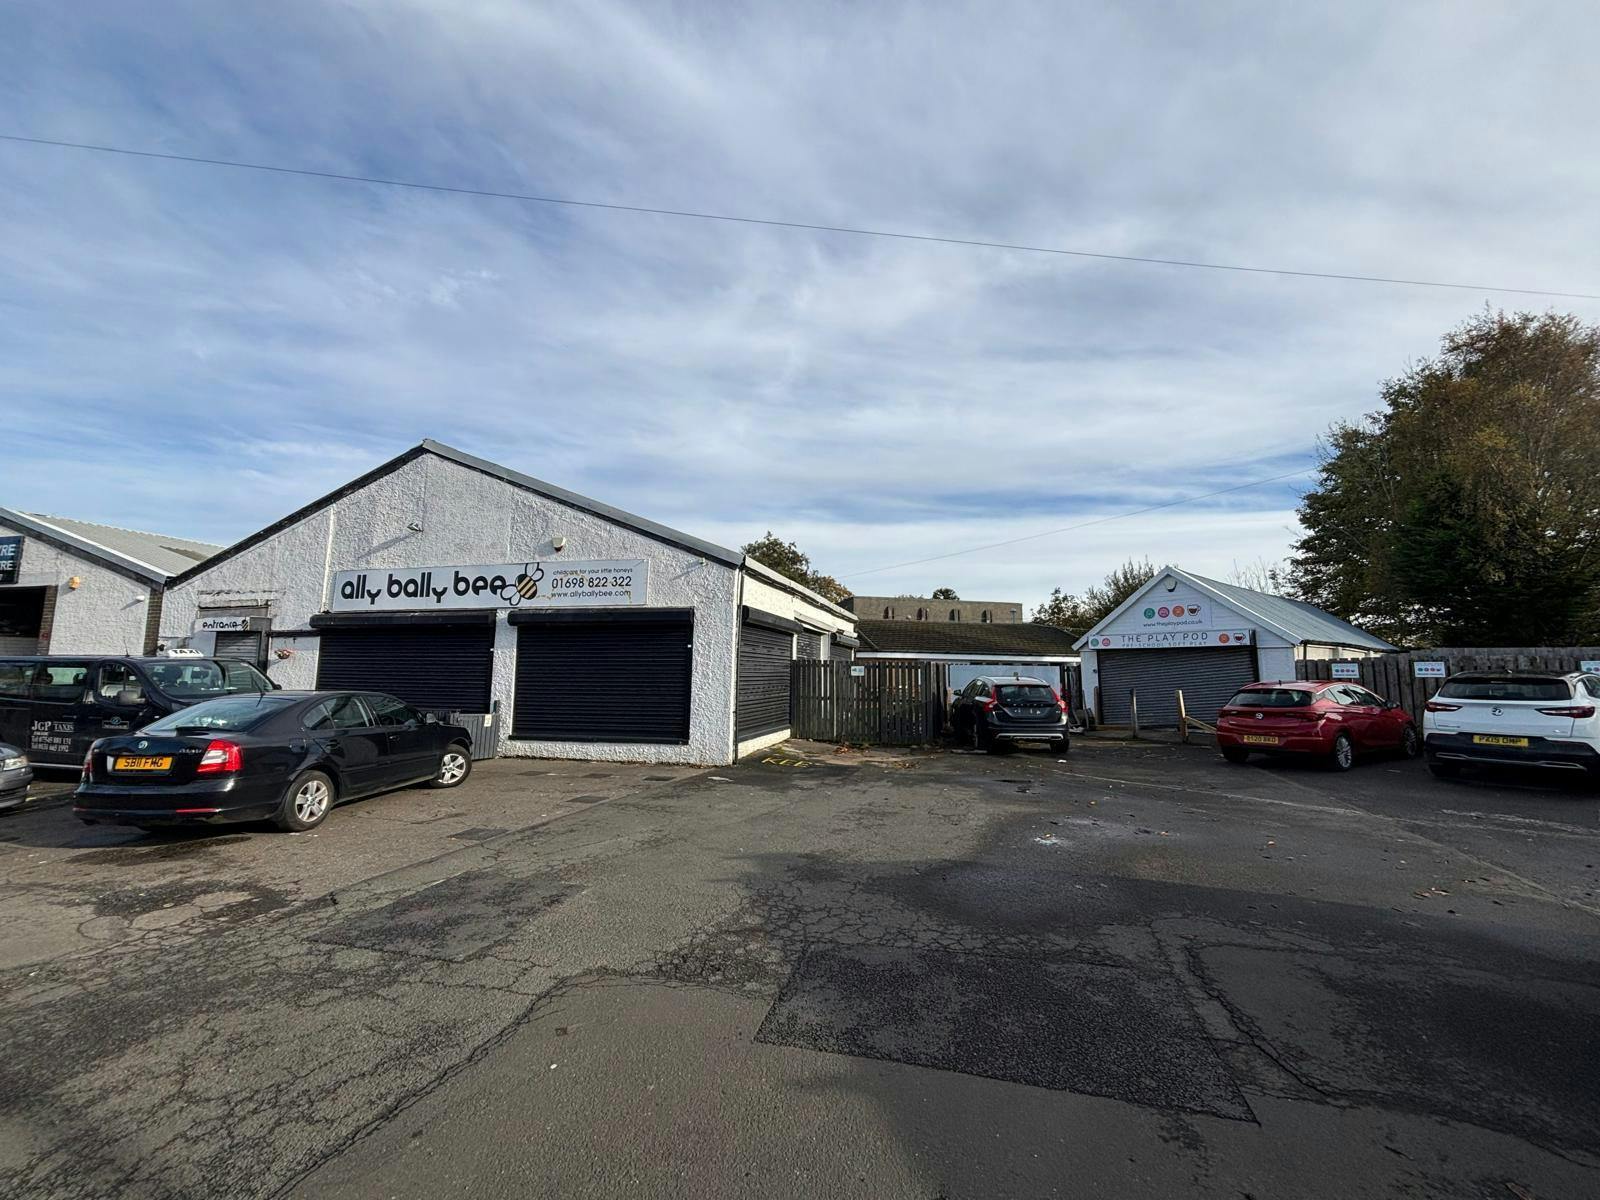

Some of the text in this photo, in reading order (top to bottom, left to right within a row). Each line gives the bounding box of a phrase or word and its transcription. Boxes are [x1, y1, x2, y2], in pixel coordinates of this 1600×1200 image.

[552, 569, 578, 577] childcare
[552, 575, 632, 589] 01698 822 322
[340, 570, 507, 605] ally bally bee
[551, 590, 631, 598] www.allyballybee.com
[202, 620, 238, 629] entrance
[1143, 619, 1203, 628] www.theplaypod.co.uk
[1121, 632, 1209, 643] THE PLAY POD
[53, 723, 74, 731] TAXIS
